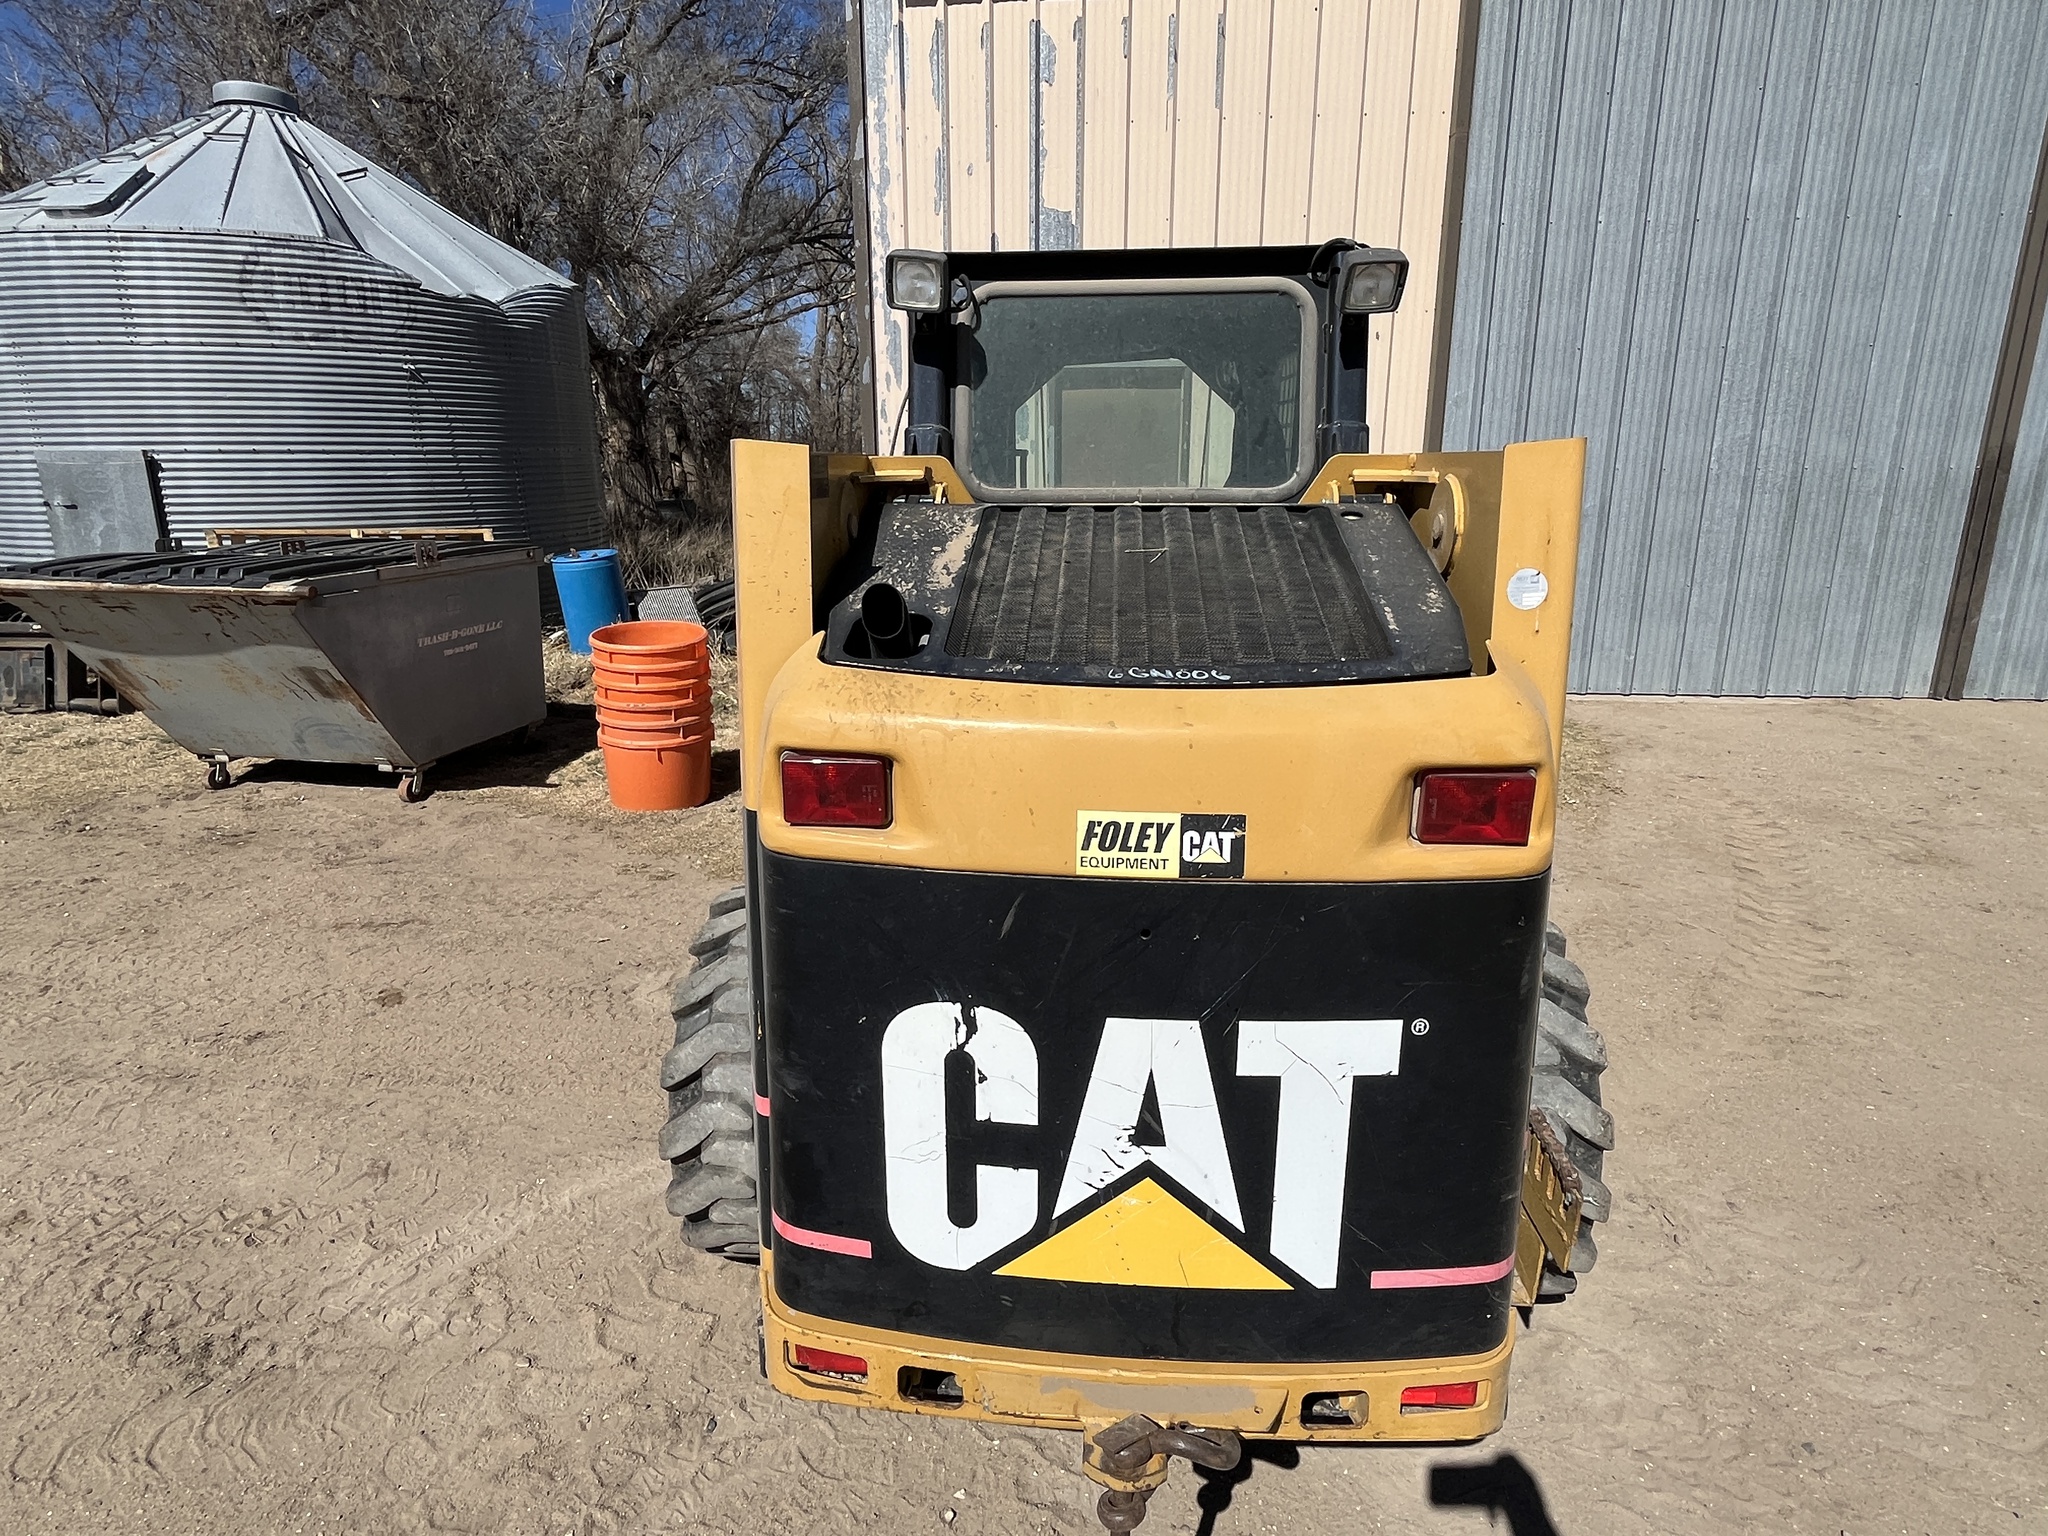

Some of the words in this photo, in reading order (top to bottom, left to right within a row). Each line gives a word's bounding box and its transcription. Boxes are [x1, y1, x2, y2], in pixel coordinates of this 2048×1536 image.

[486, 620, 503, 632] LLC
[1080, 820, 1175, 854] FOLEY
[1182, 829, 1236, 864] CAT
[1080, 856, 1170, 870] EQUIPMENT
[881, 1001, 1404, 1289] CAT
